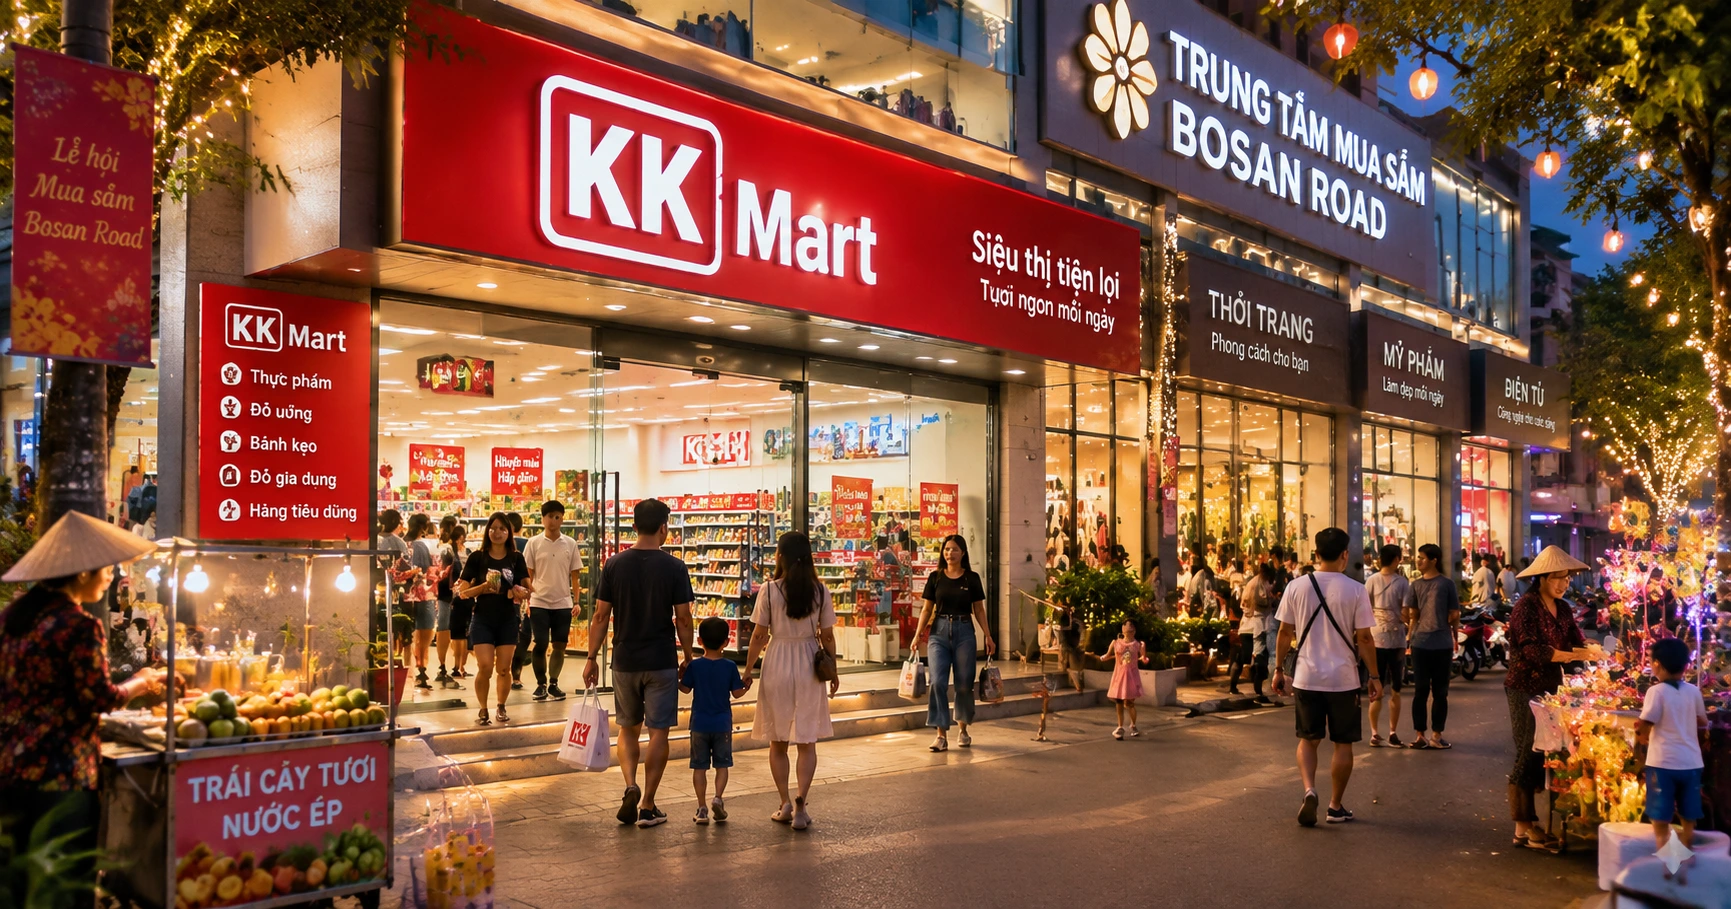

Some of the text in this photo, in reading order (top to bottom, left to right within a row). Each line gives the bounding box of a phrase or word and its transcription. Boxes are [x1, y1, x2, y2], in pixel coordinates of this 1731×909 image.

[1169, 30, 1271, 126] TRUNG
[1335, 123, 1382, 184] MUA
[29, 172, 85, 203] Mua
[1172, 99, 1387, 240] BOSAN ROAD
[568, 113, 878, 286] KK Mart
[22, 210, 145, 250] Bosan Road
[972, 229, 1019, 275] Siệu
[1025, 245, 1051, 288] thị
[1057, 257, 1094, 297] tiện
[1018, 293, 1054, 318] ngon
[1256, 303, 1314, 344] TRANG
[233, 313, 347, 352] KK Mart
[1211, 331, 1245, 361] Phong
[1273, 348, 1290, 367] cho
[1292, 351, 1309, 374] bạn
[250, 435, 318, 456] Bánh kẹo
[276, 470, 298, 488] gia
[302, 471, 337, 490] dụng
[291, 504, 319, 519] tiêu
[187, 764, 251, 804] TRÁI
[222, 795, 343, 840] NƯỚC ÉP
